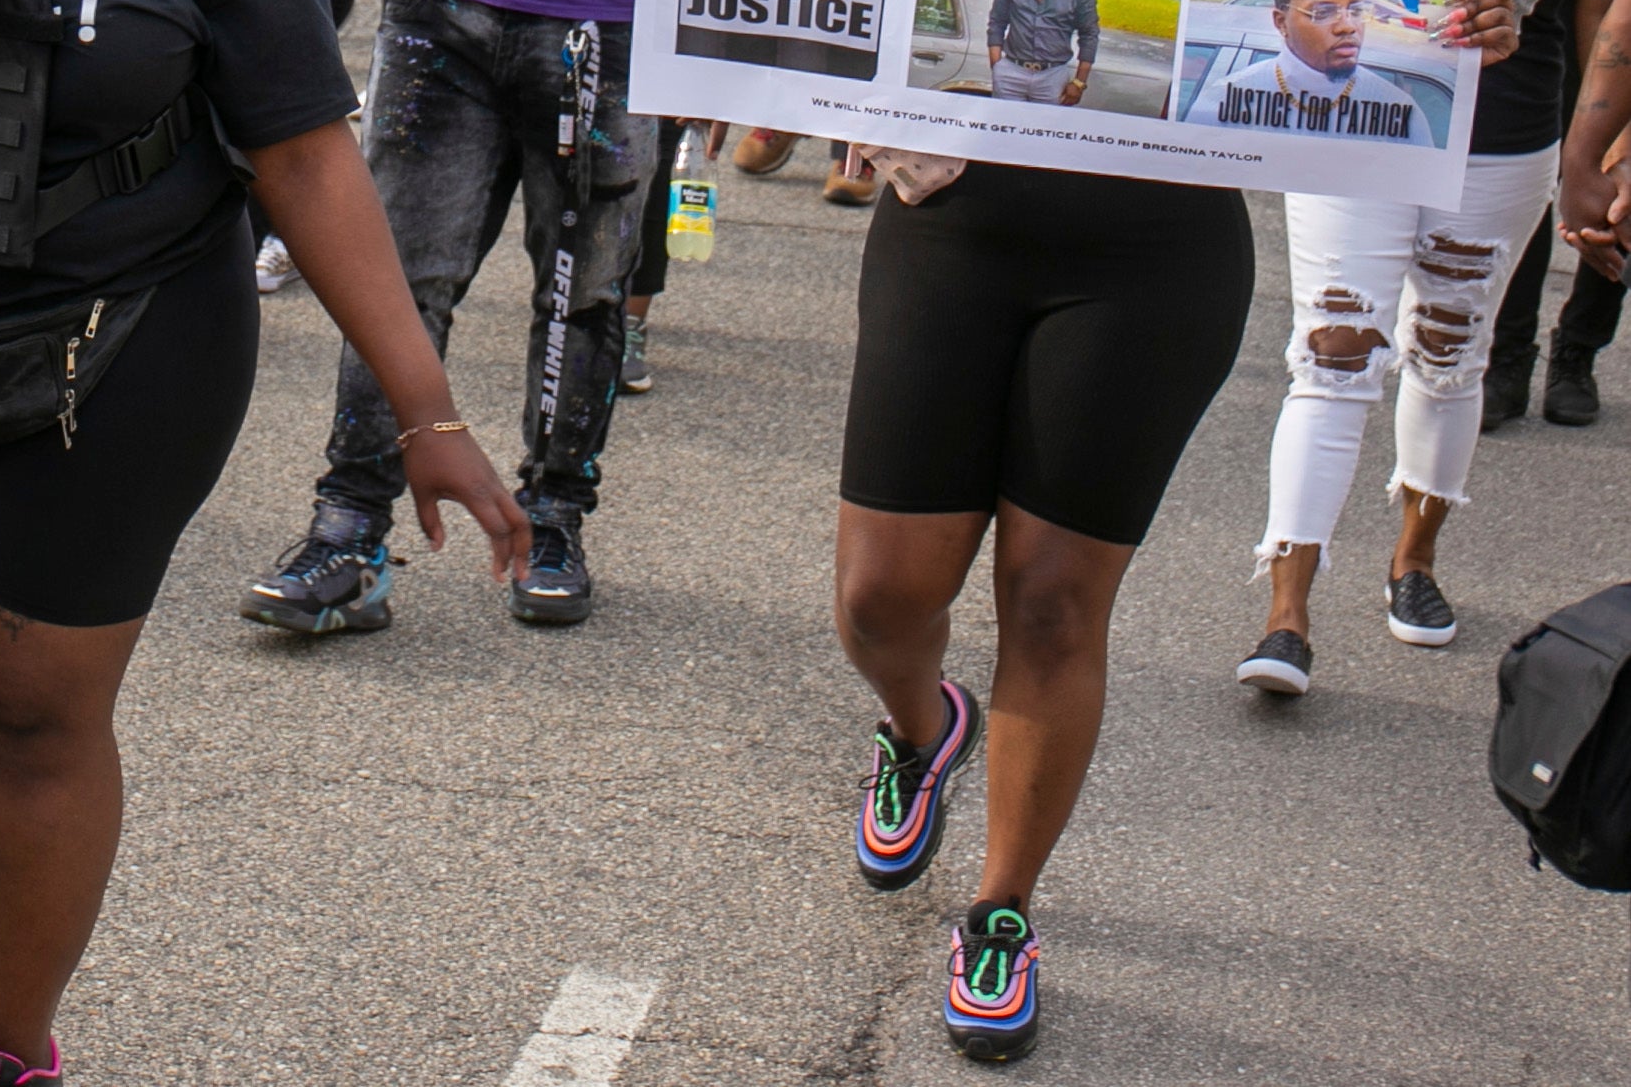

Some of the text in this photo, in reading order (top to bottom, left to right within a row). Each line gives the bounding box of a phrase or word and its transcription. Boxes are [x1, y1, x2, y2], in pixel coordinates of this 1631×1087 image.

[811, 96, 1263, 162] WE WILL NOT STOP UNTIL WE GET JUSTICE! ALSO RIP BREONNA TAYLOR
